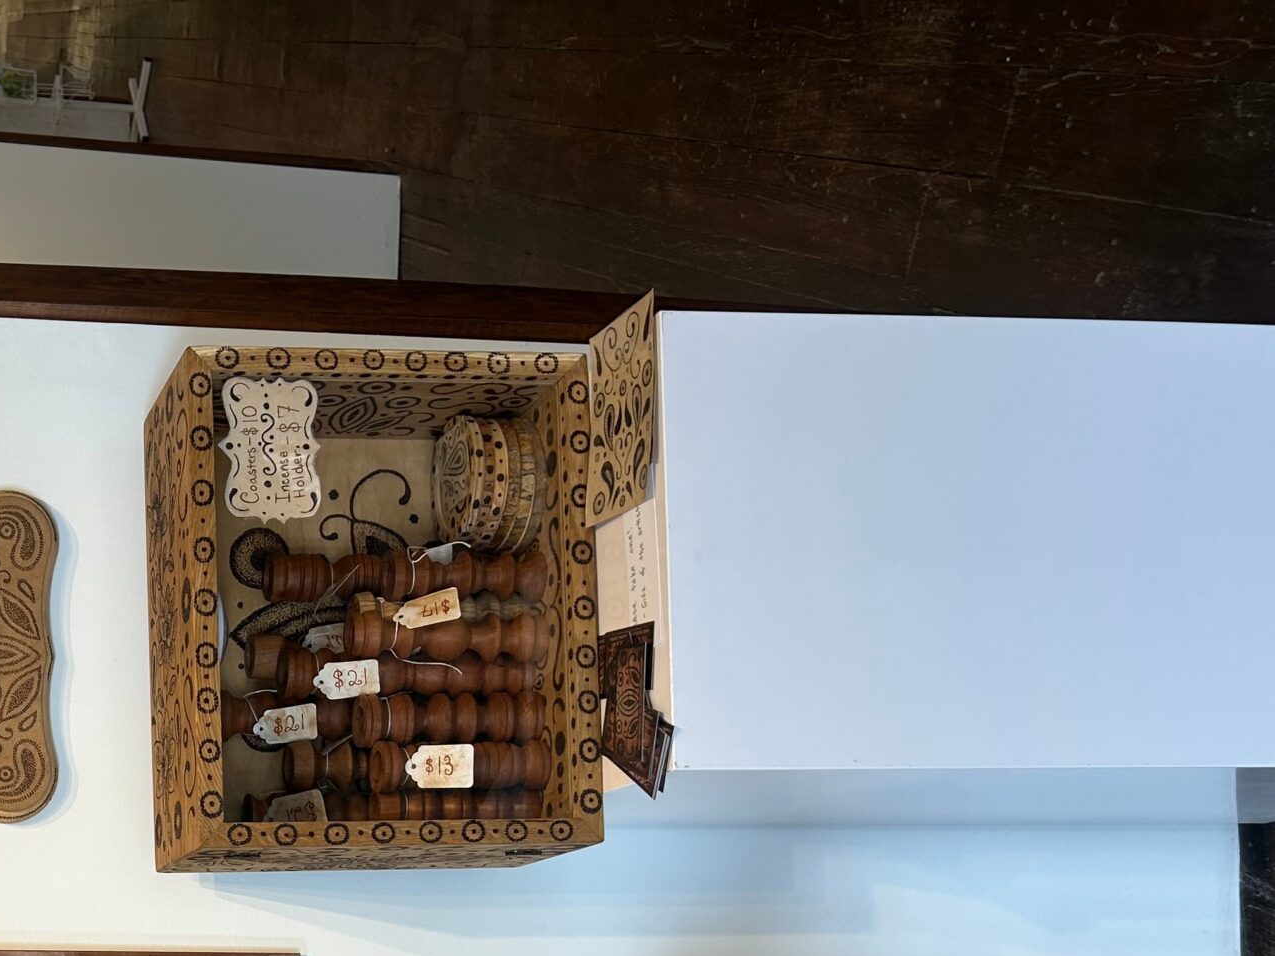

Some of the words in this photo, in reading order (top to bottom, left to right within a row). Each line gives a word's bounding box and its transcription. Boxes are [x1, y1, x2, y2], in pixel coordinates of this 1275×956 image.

[274, 451, 291, 503] Incense
[421, 598, 451, 617] $17
[333, 668, 367, 690] $21
[273, 714, 304, 736] $21
[425, 754, 454, 776] $13
